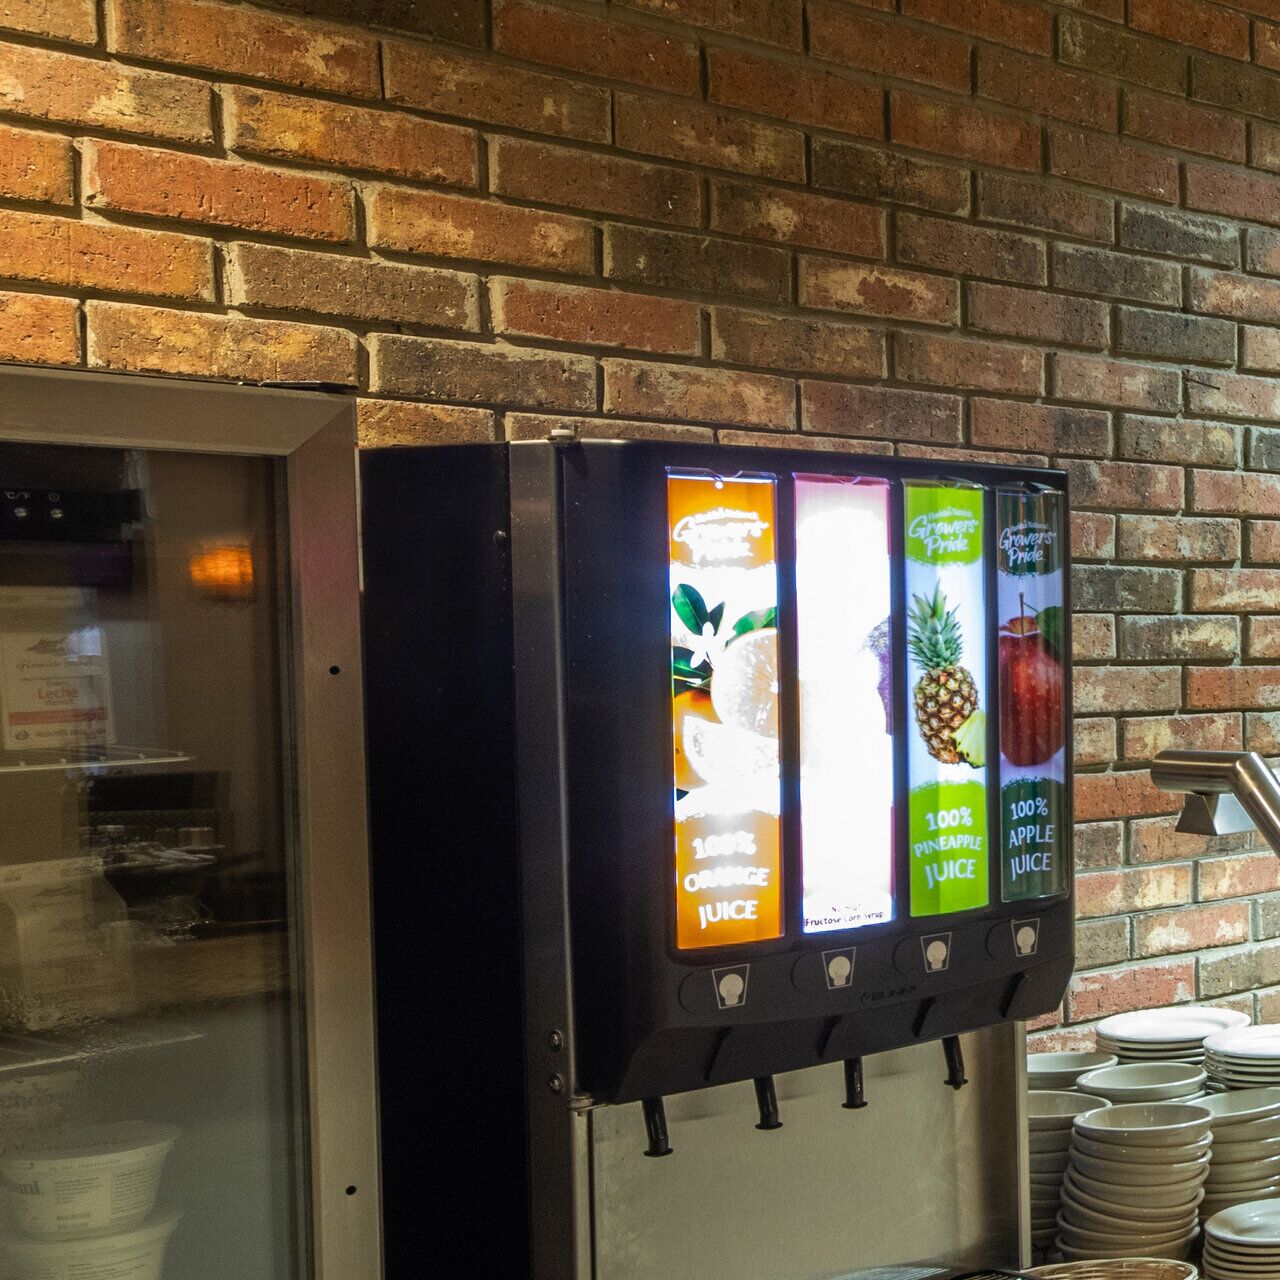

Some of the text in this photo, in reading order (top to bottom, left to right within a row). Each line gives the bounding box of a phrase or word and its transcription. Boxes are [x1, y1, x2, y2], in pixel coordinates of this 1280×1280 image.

[923, 531, 968, 557] Pride
[1007, 544, 1043, 567] Pride
[925, 806, 972, 831] 100%
[1010, 797, 1048, 821] 100%
[913, 834, 982, 858] PINEAPPLE
[1009, 824, 1055, 849] APPLE
[924, 858, 976, 889] JUICE
[1010, 852, 1052, 881] JUICE
[698, 899, 759, 930] JUICE
